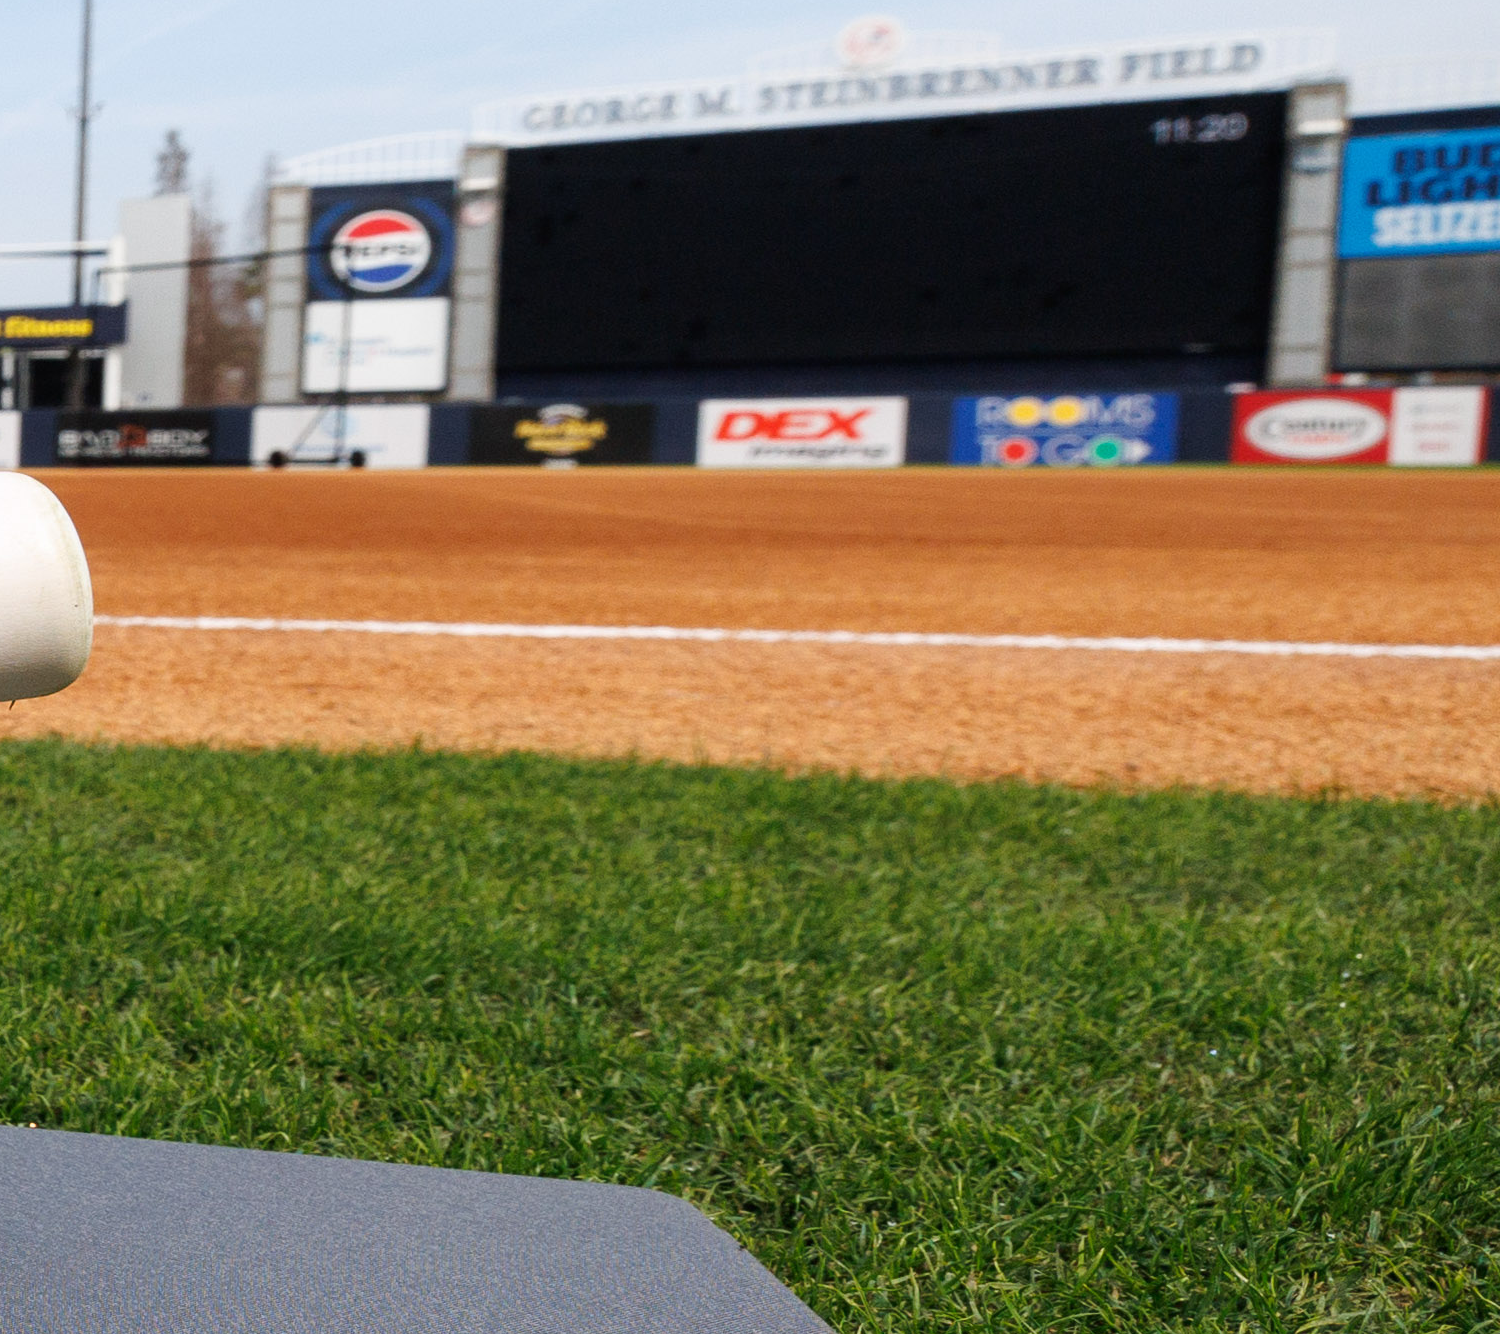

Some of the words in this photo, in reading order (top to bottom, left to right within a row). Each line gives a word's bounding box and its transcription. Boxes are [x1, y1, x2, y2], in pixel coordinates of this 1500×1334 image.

[523, 90, 678, 132] GEORGE
[759, 58, 1099, 112] STEINBRENNER
[1118, 43, 1263, 85] FIELD
[1366, 174, 1500, 208] LIGH
[1372, 200, 1500, 248] SELTZE
[3, 315, 94, 341] fitness
[714, 407, 875, 442] DEX
